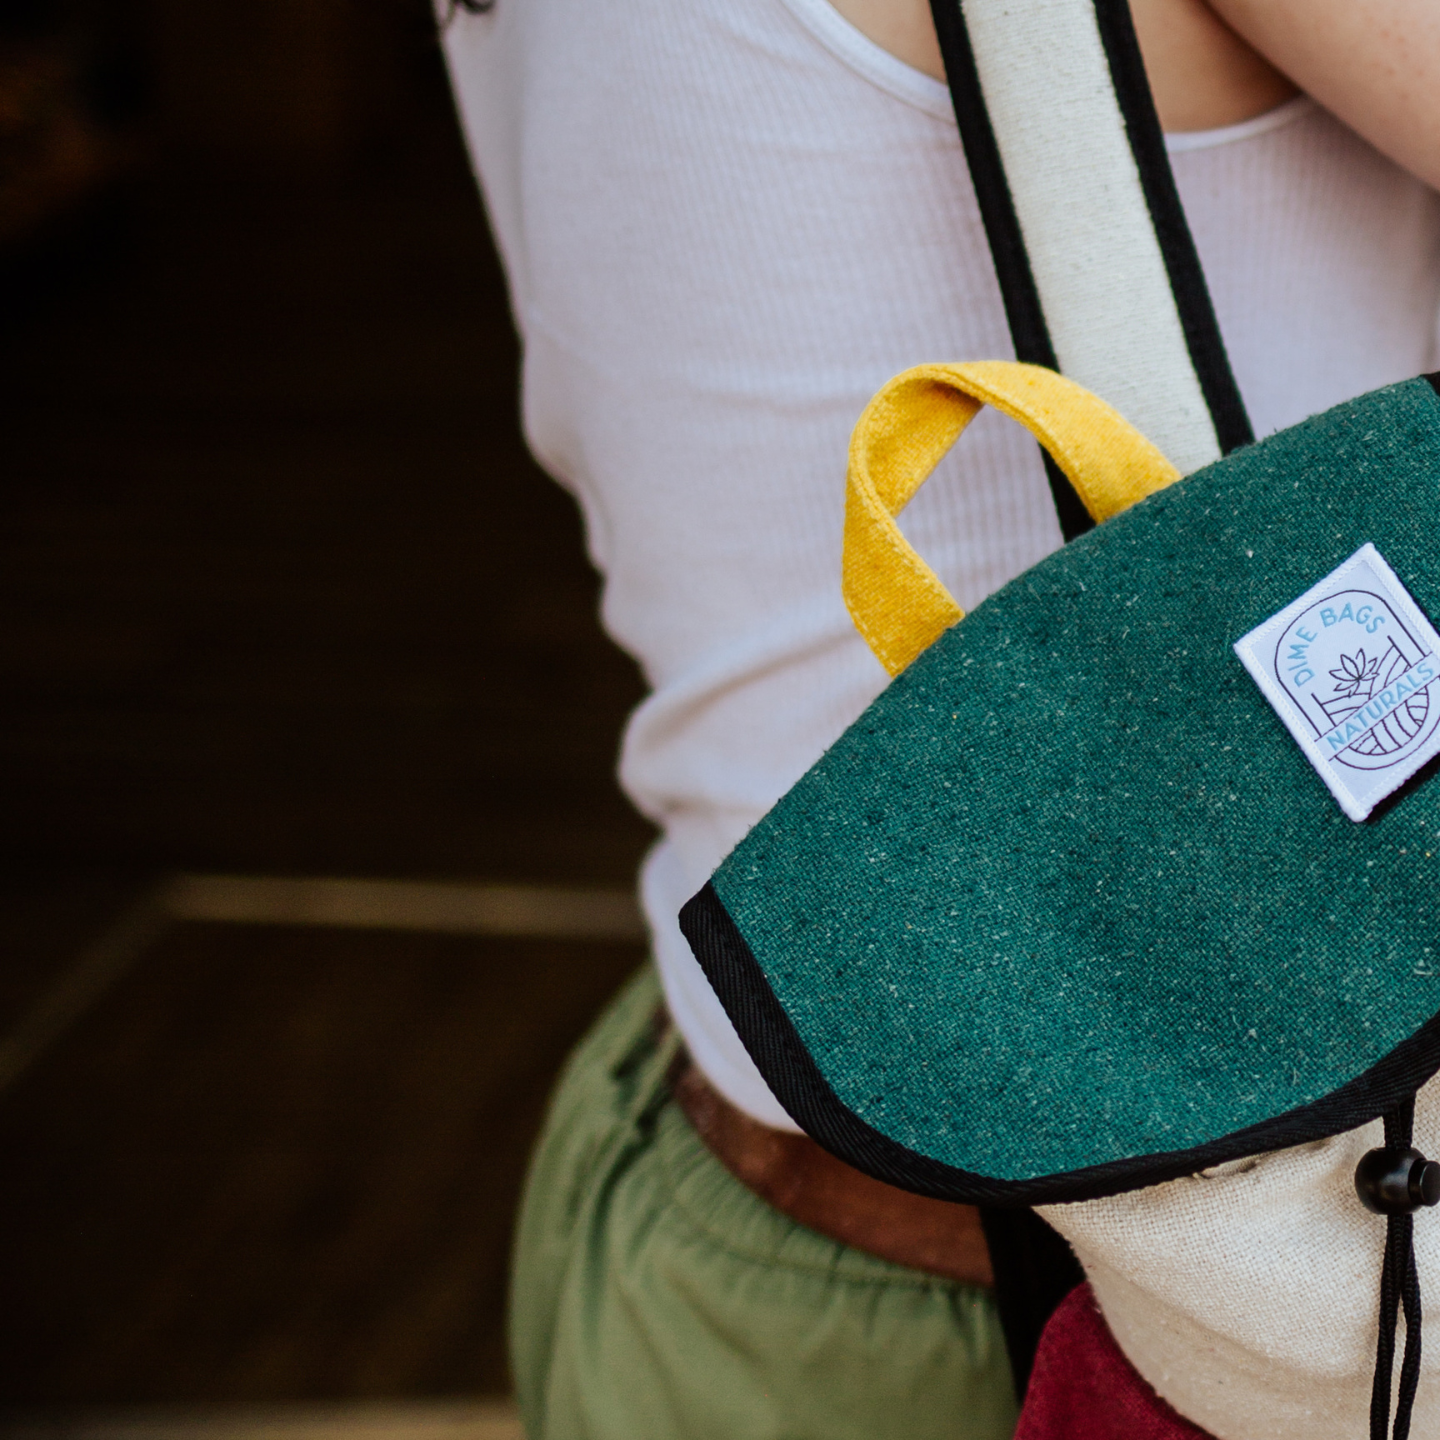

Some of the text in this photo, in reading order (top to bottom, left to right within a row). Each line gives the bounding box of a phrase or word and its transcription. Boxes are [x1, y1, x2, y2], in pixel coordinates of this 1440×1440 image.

[1287, 601, 1386, 688] DIME BAGS
[1325, 661, 1435, 752] NATURALS
